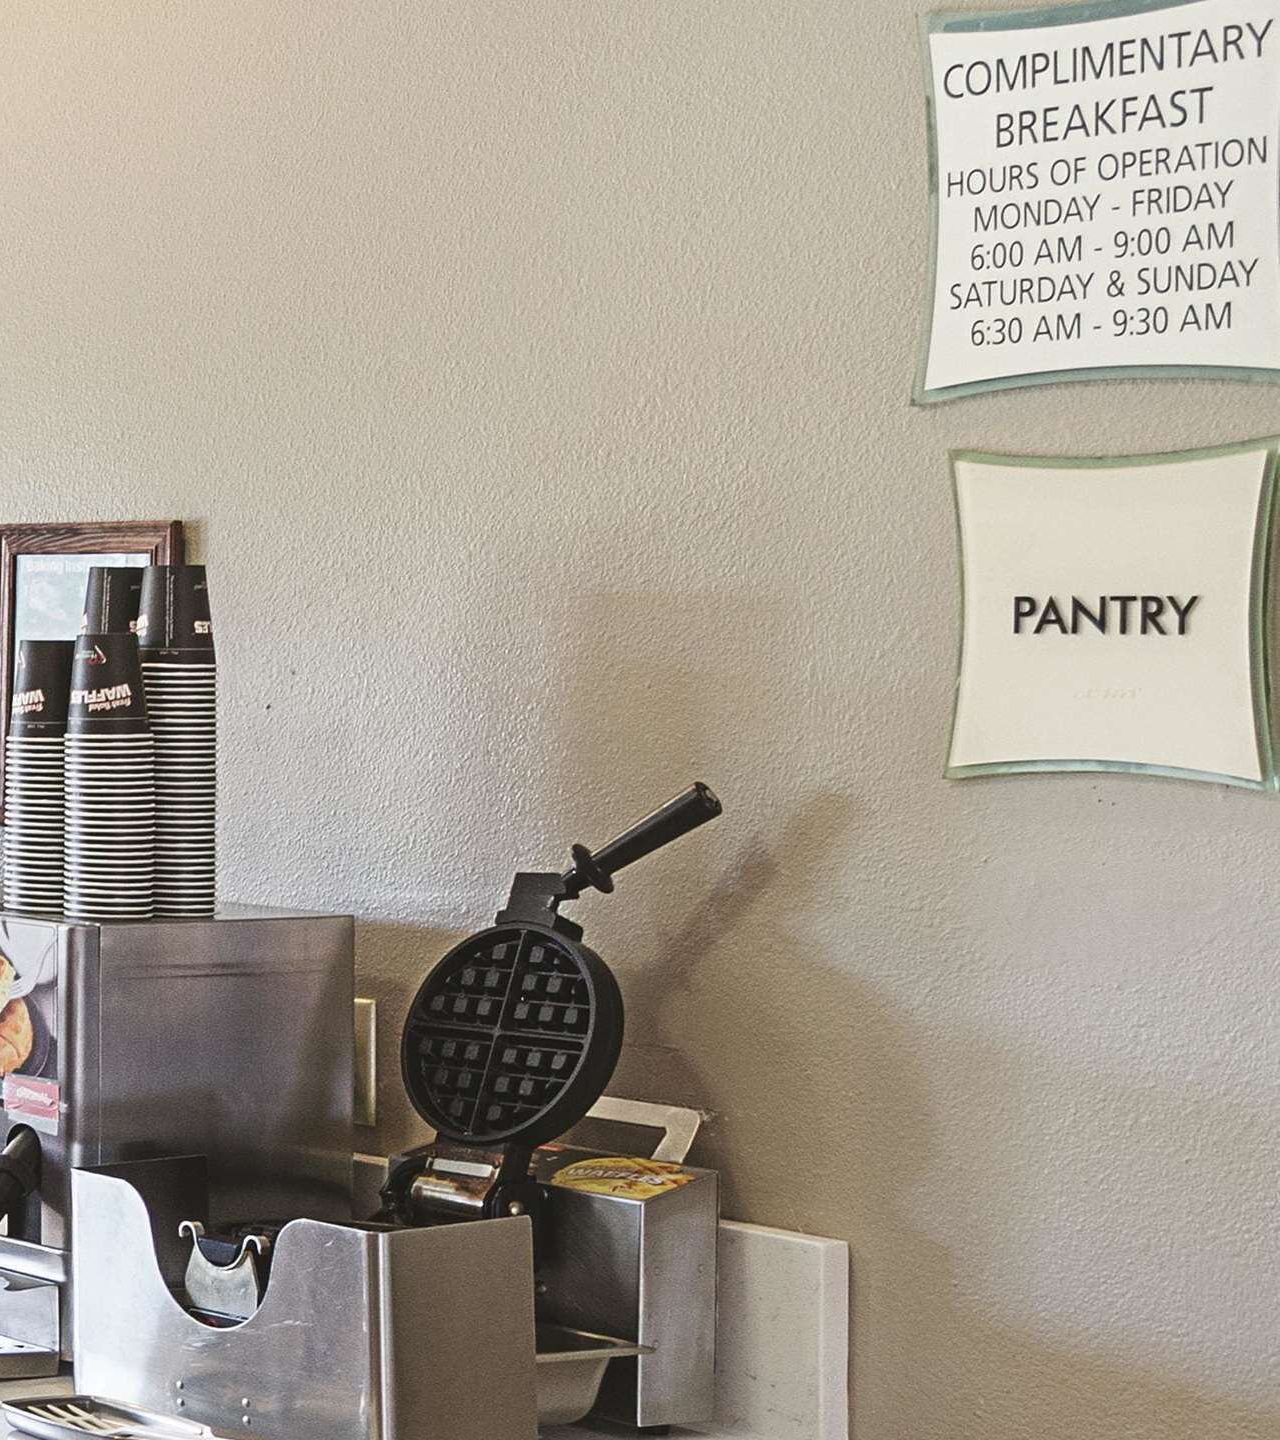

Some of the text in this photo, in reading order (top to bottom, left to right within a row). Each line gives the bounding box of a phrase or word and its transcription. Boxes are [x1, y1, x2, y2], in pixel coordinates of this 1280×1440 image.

[943, 18, 1274, 99] COMPLIMENTARY
[996, 86, 1214, 148] BREAKFAST
[946, 135, 1268, 198] HOURS OF OPERATION
[973, 194, 1101, 233] MONDAY
[1131, 179, 1234, 217] FRIDAY
[970, 241, 1024, 271] 6:00
[1034, 235, 1082, 265] AM
[1113, 227, 1172, 259] 9:00
[1182, 220, 1235, 252] AM
[949, 258, 1259, 310] SATURDAY & SUNDAY
[970, 318, 1023, 347] 6:30
[1032, 312, 1082, 343] AM
[1112, 308, 1169, 338] 9:30
[1179, 302, 1233, 332] AM
[1012, 595, 1199, 636] PANTRY
